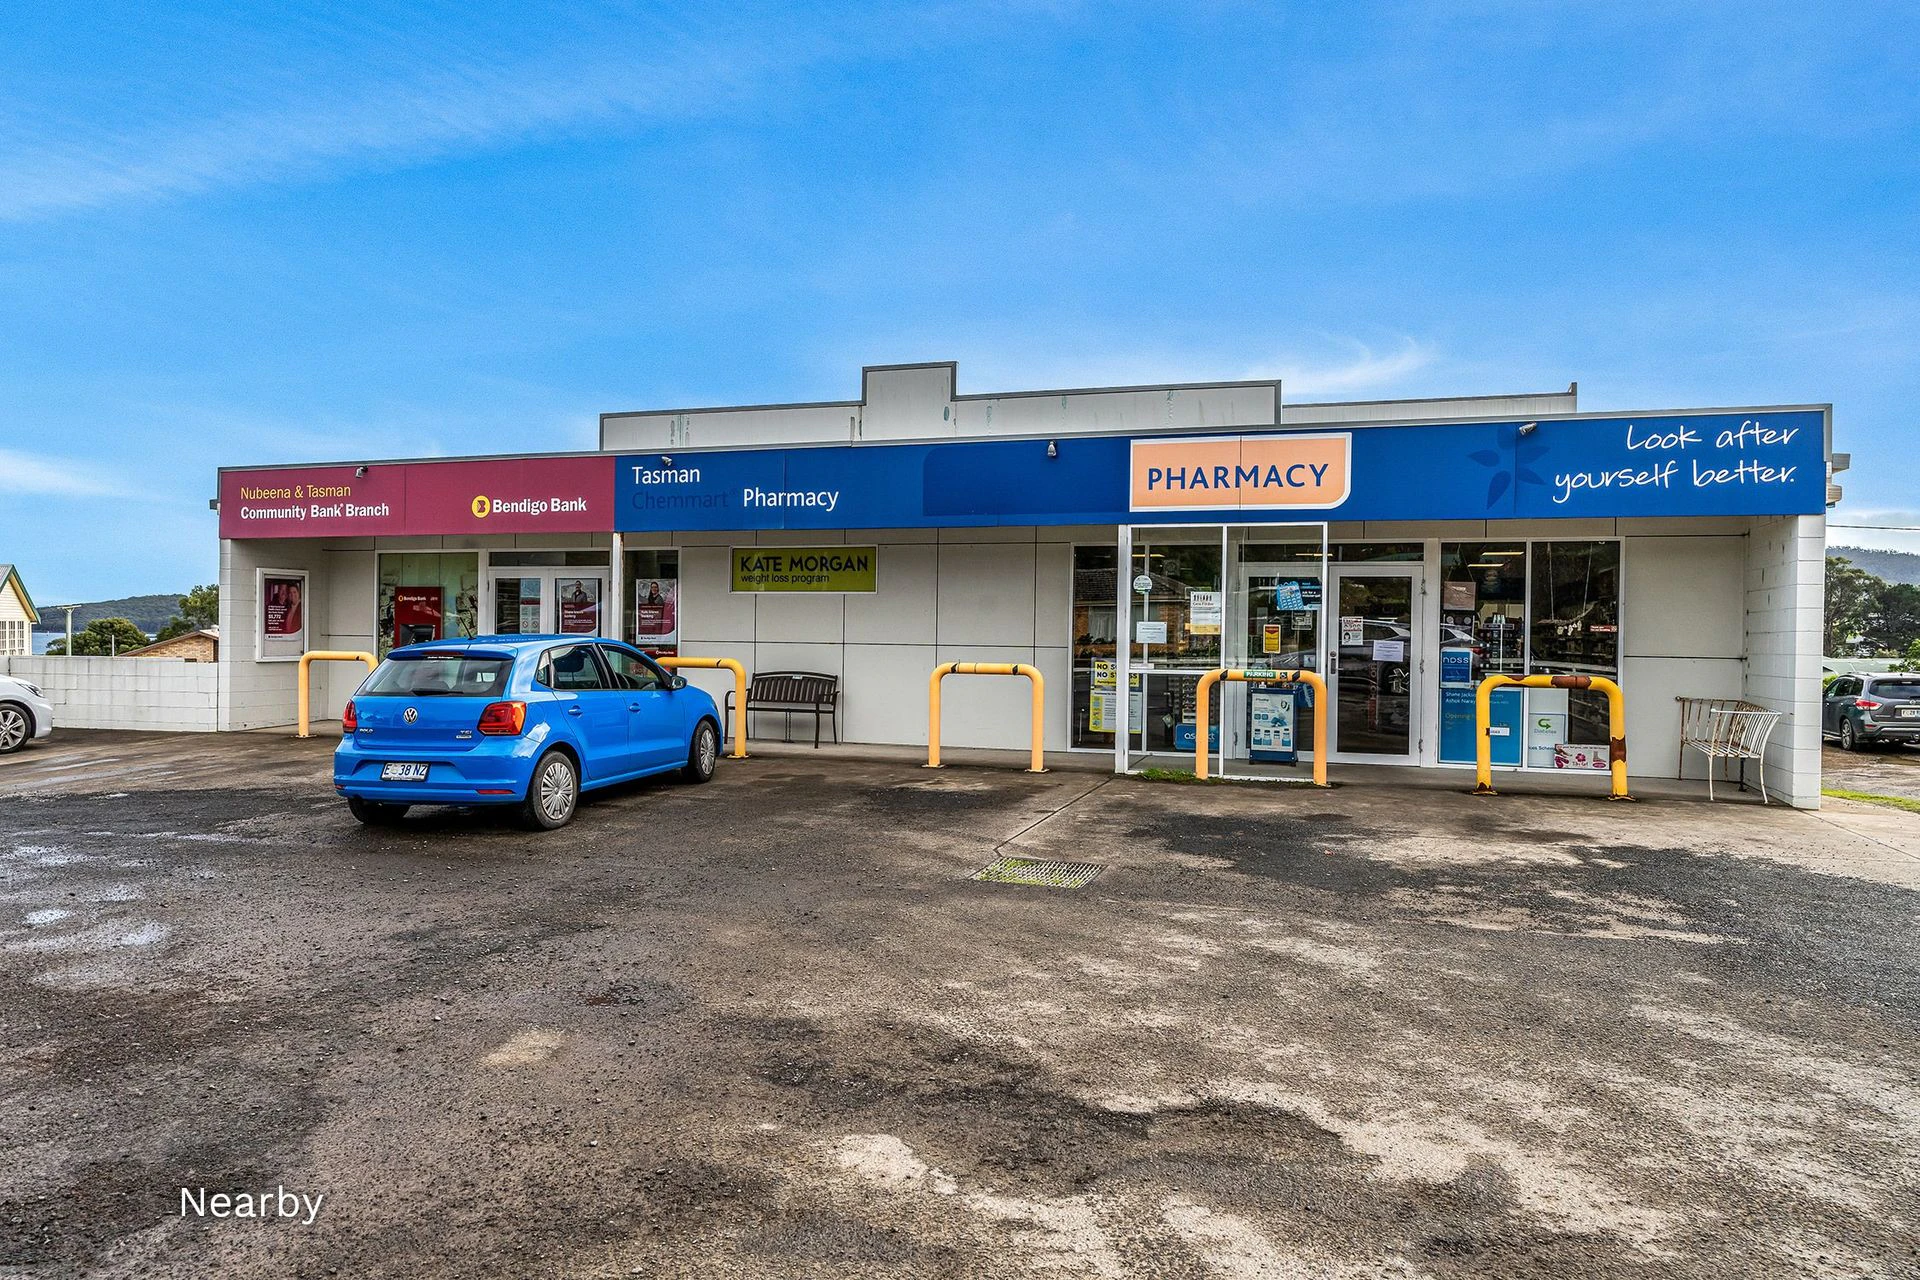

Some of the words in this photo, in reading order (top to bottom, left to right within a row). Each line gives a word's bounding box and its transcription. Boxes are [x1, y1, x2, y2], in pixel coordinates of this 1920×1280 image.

[1626, 424, 1703, 450] Look
[1715, 420, 1800, 449] after
[632, 466, 701, 484] Tasman
[1148, 463, 1329, 490] PHARMACY
[1552, 460, 1679, 504] yourself
[1692, 459, 1797, 487] better.
[240, 487, 291, 499] Nubeena
[294, 485, 304, 498] &
[306, 484, 351, 498] Tasman
[743, 487, 840, 512] Pharmacy
[240, 504, 307, 520] Community
[345, 503, 390, 517] Branch
[492, 499, 548, 515] Bendigo
[550, 497, 587, 512] Bank
[740, 556, 782, 572] KATE
[789, 555, 868, 572] MORGAN
[741, 574, 769, 584] weight
[771, 573, 789, 583] loss
[791, 574, 830, 584] program
[384, 764, 392, 775] E
[399, 765, 411, 776] 38
[413, 765, 427, 776] NZ
